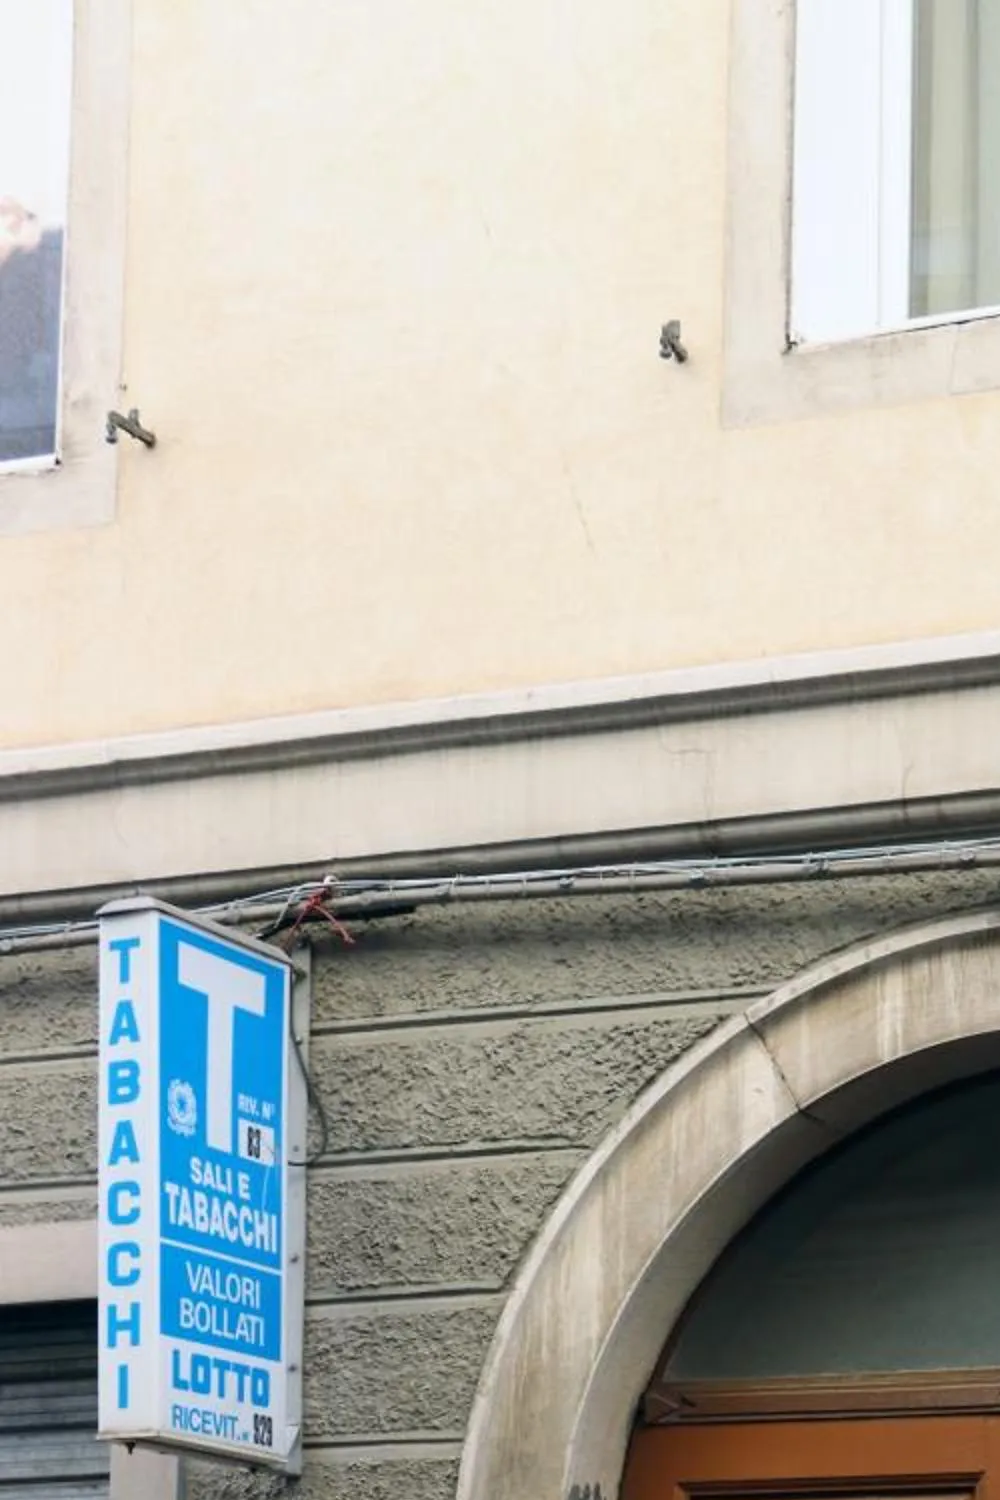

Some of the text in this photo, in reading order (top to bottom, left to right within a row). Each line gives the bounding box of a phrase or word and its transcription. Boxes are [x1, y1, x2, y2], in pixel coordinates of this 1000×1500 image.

[177, 940, 267, 1154] T
[106, 936, 142, 1410] TABACCHI
[189, 1155, 251, 1201] SALI E
[164, 1181, 278, 1254] TABACCHI
[185, 1260, 261, 1310] VALORI
[179, 1296, 266, 1347] BOLLATI
[171, 1348, 271, 1409] LOTTO
